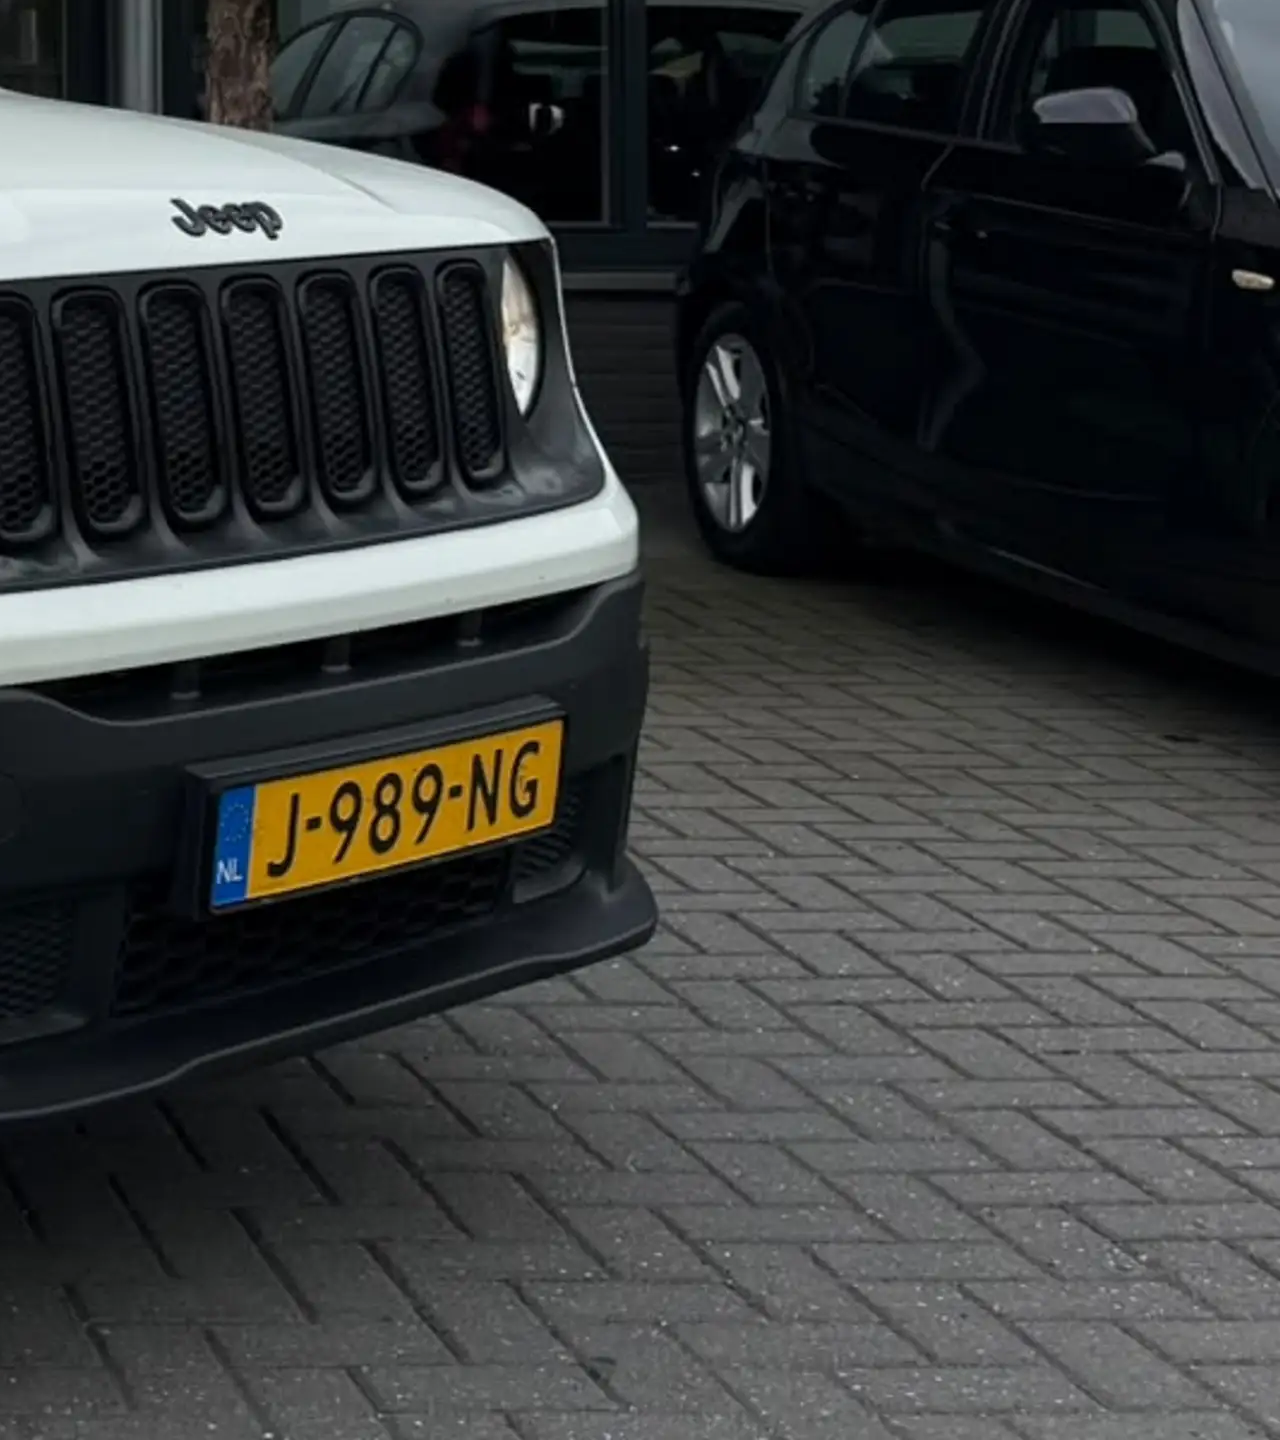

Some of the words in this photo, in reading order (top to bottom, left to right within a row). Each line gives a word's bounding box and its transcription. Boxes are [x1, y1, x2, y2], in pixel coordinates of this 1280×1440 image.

[169, 197, 283, 240] Jeep
[267, 740, 540, 877] J-989-NG
[215, 859, 243, 884] NL
